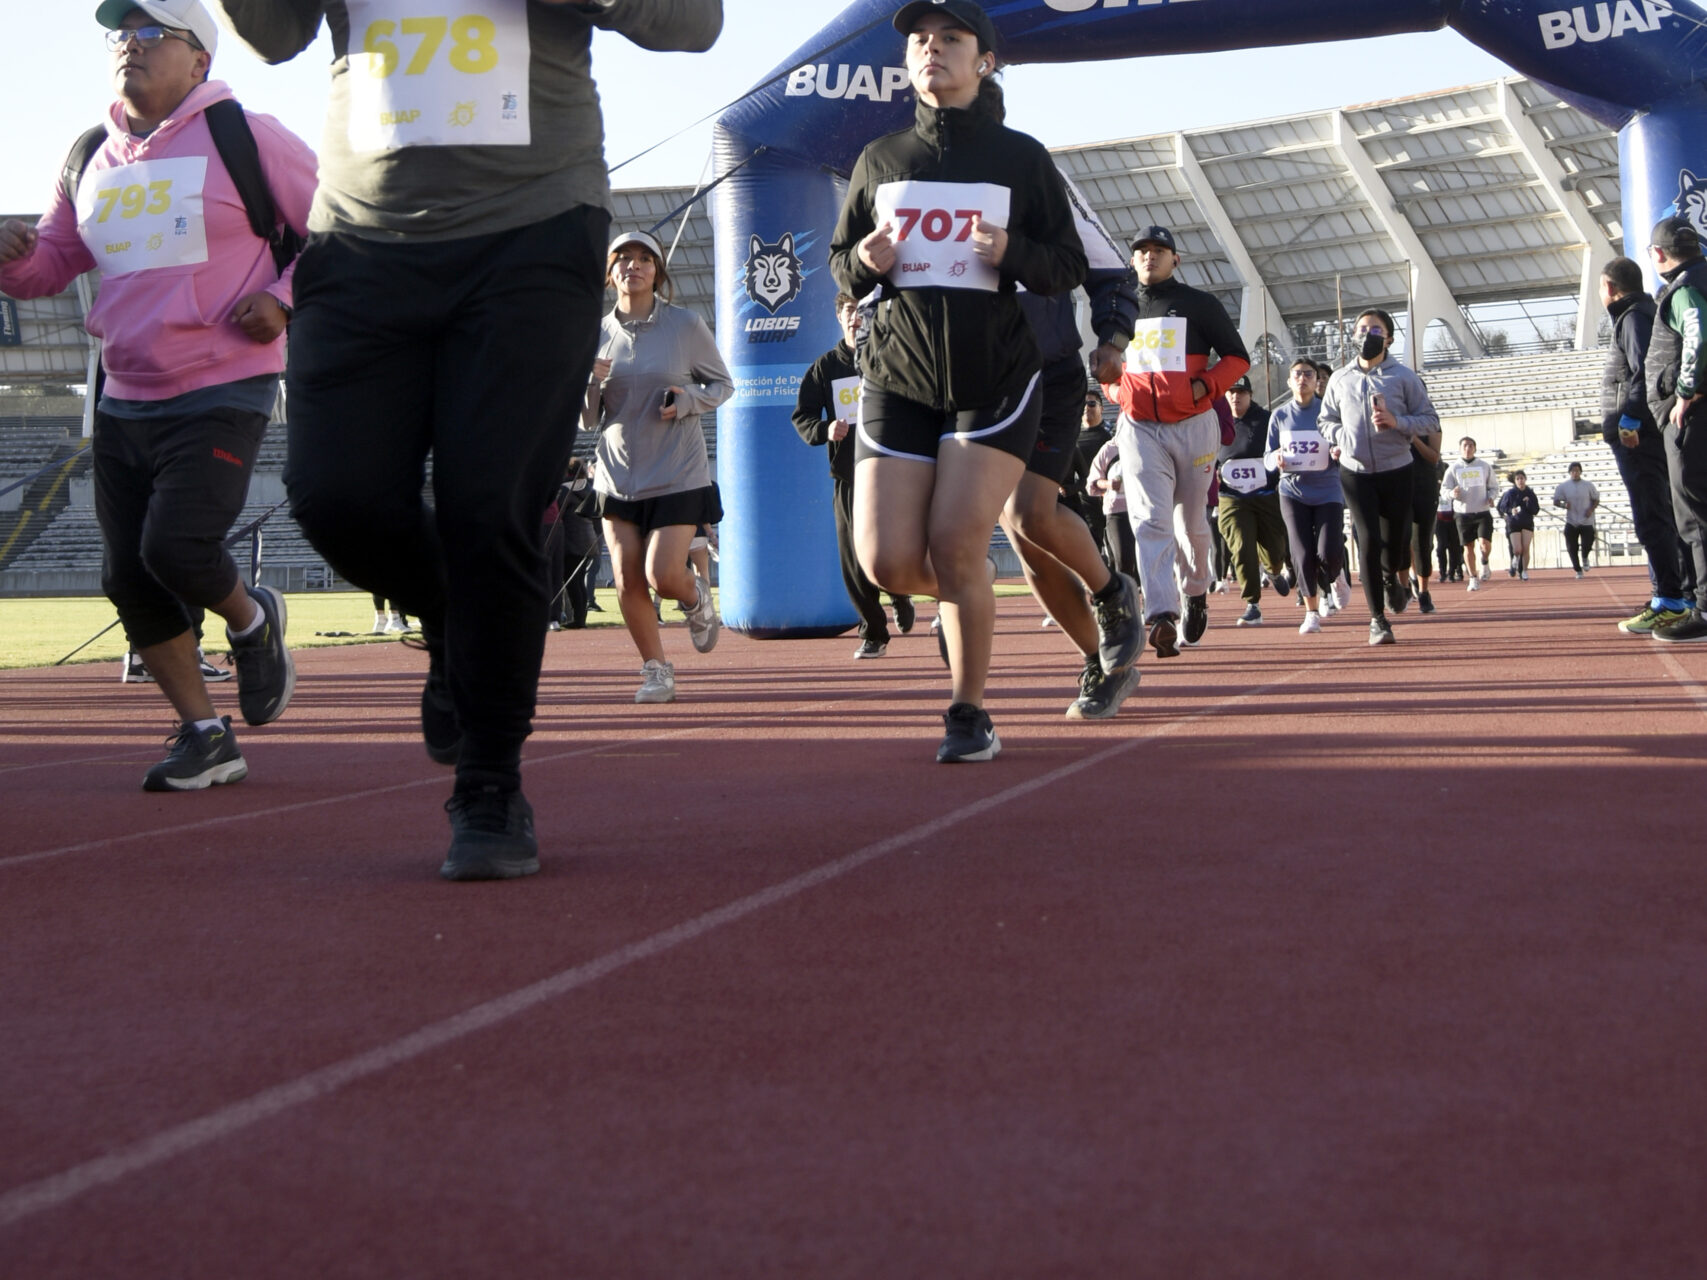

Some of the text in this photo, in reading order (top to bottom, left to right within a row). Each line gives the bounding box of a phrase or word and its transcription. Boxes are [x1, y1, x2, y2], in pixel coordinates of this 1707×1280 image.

[363, 14, 499, 79] 678
[785, 63, 912, 102] BUAP
[380, 109, 421, 126] BUAP
[97, 179, 172, 223] 793
[895, 208, 982, 242] 707
[106, 241, 131, 254] BUAP
[902, 263, 931, 272] BUAP
[744, 316, 801, 332] LOBOS
[747, 329, 797, 344] BUAP
[1131, 328, 1176, 350] 663
[734, 376, 773, 387] Dirección
[775, 376, 787, 385] de
[740, 387, 771, 397] Cultura
[1289, 440, 1320, 454] 632
[1231, 467, 1256, 480] 631
